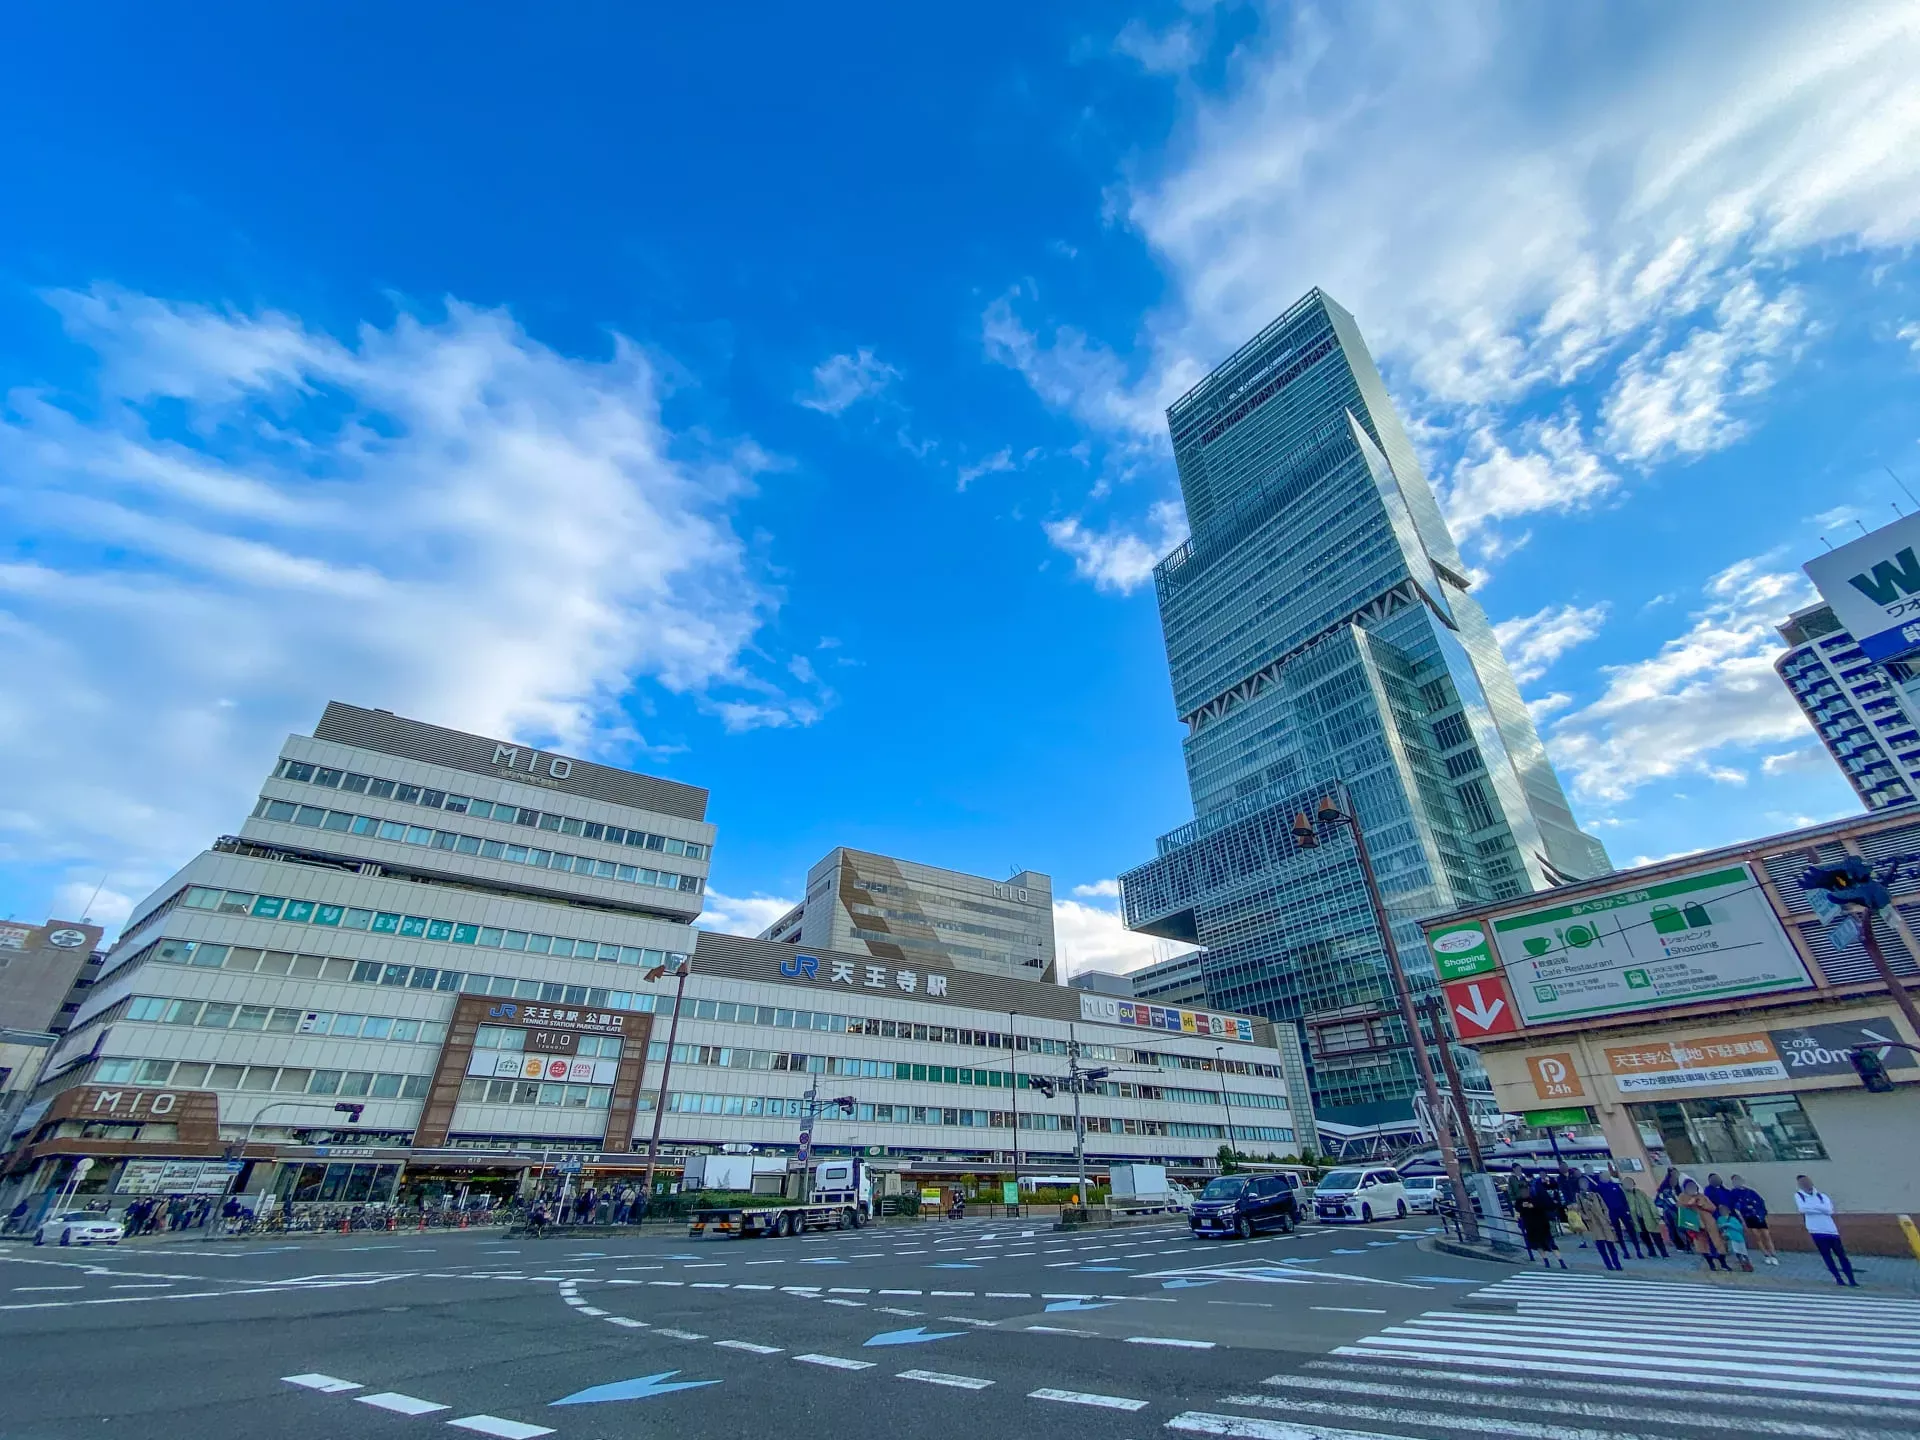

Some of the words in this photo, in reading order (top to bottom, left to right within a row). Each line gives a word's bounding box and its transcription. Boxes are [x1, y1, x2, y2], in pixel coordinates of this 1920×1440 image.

[491, 743, 573, 779] MIO
[992, 883, 1028, 902] MIO
[259, 898, 340, 922] ニトリ
[374, 916, 465, 939] EXPRESS
[1671, 941, 1720, 955] Shopping
[780, 953, 819, 979] JR
[1443, 954, 1486, 967] Shopping
[1457, 963, 1476, 972] mall
[830, 960, 948, 997] 天王寺駅
[489, 1003, 518, 1019] JR
[523, 1006, 579, 1021] 天王寺駅
[585, 1012, 624, 1025] 公園口
[1083, 998, 1116, 1017] MIO
[1120, 1007, 1134, 1018] GU
[522, 1017, 549, 1026] TENNOJI
[549, 1020, 575, 1028] STATION
[606, 1025, 622, 1033] GATE
[536, 1032, 571, 1046] MIO
[1781, 1037, 1819, 1049] この先
[1786, 1048, 1853, 1067] 200m
[1538, 1058, 1566, 1083] P
[1546, 1083, 1572, 1095] 24h
[93, 1090, 177, 1114] MIO
